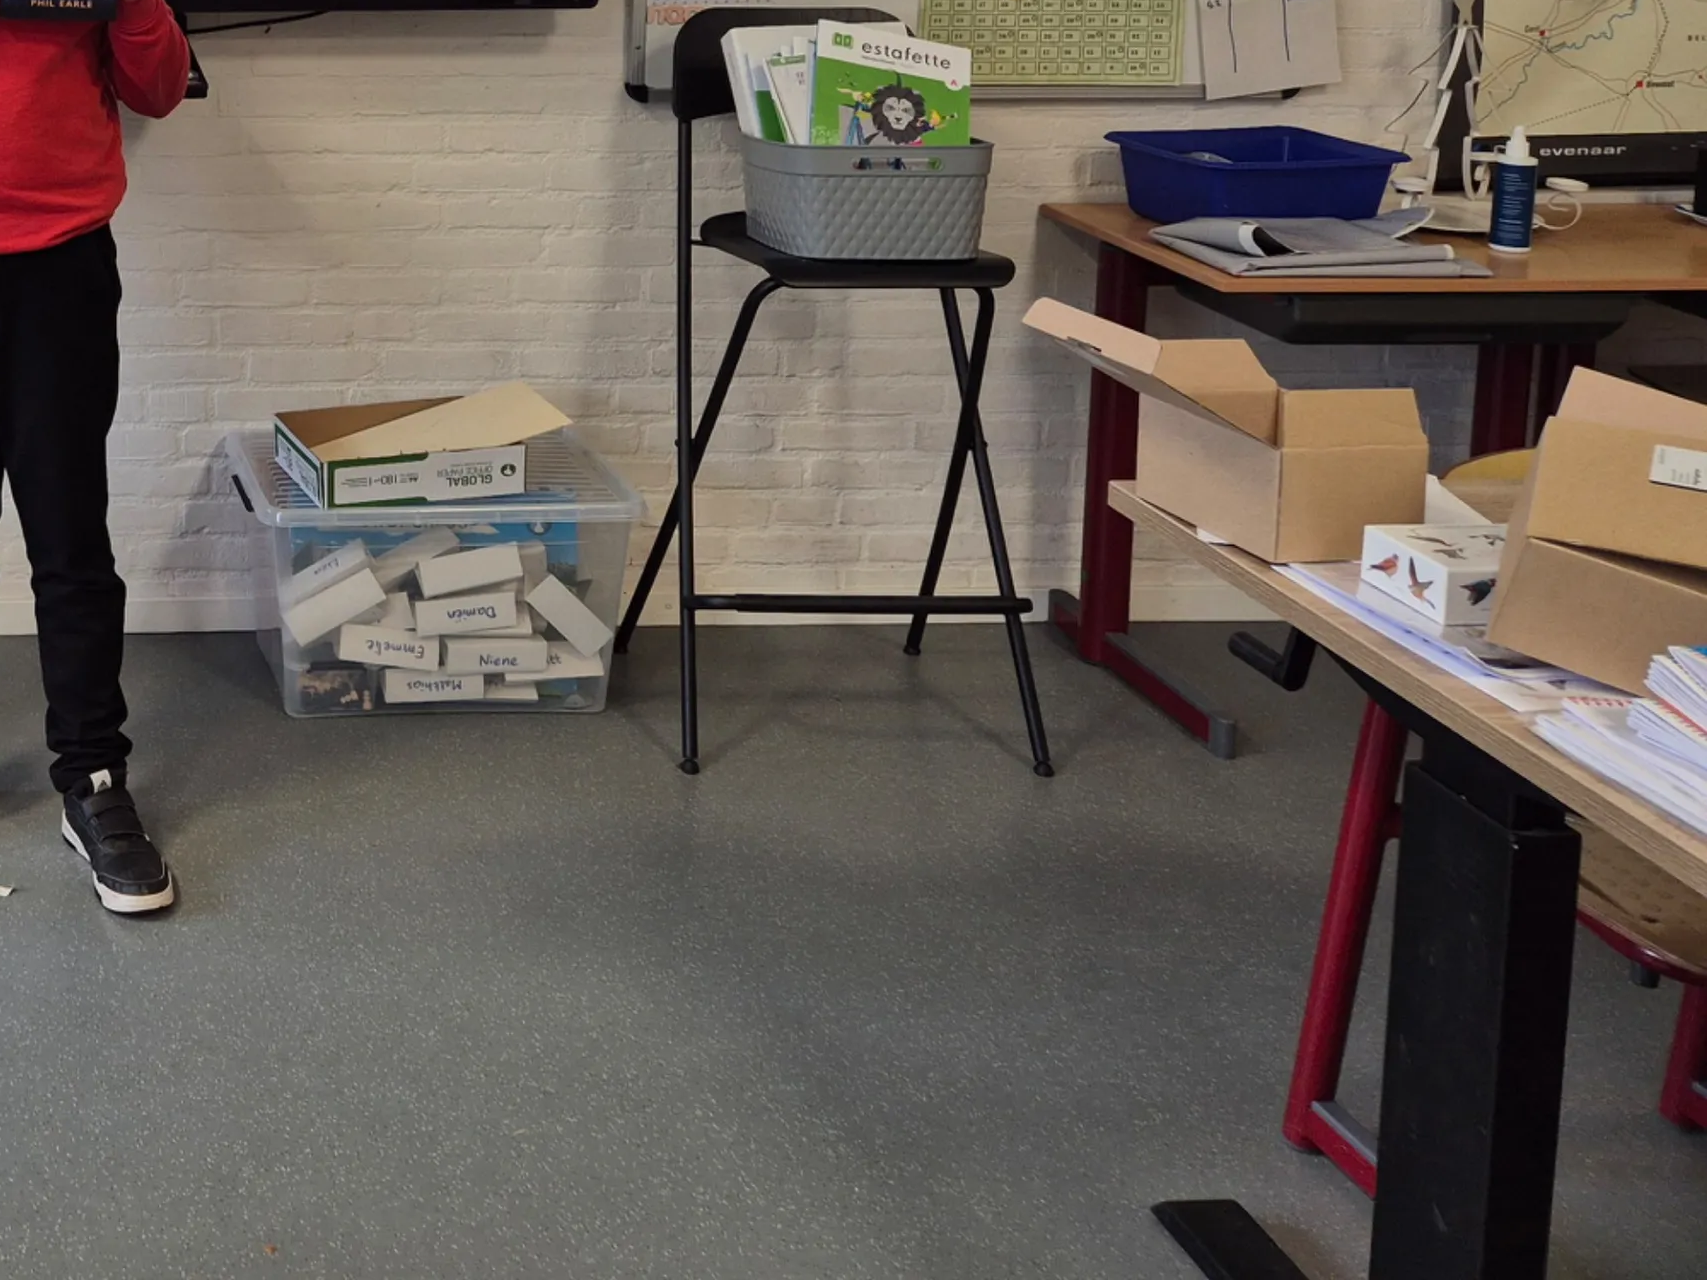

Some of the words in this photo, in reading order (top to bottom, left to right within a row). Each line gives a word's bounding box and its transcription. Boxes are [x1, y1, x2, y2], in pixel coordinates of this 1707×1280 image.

[30, 0, 55, 8] PHIL
[58, 0, 93, 9] EARLE
[861, 40, 952, 70] estafette
[1539, 146, 1627, 157] evenaar
[446, 474, 493, 487] GLOBAL
[479, 652, 519, 667] Niene
